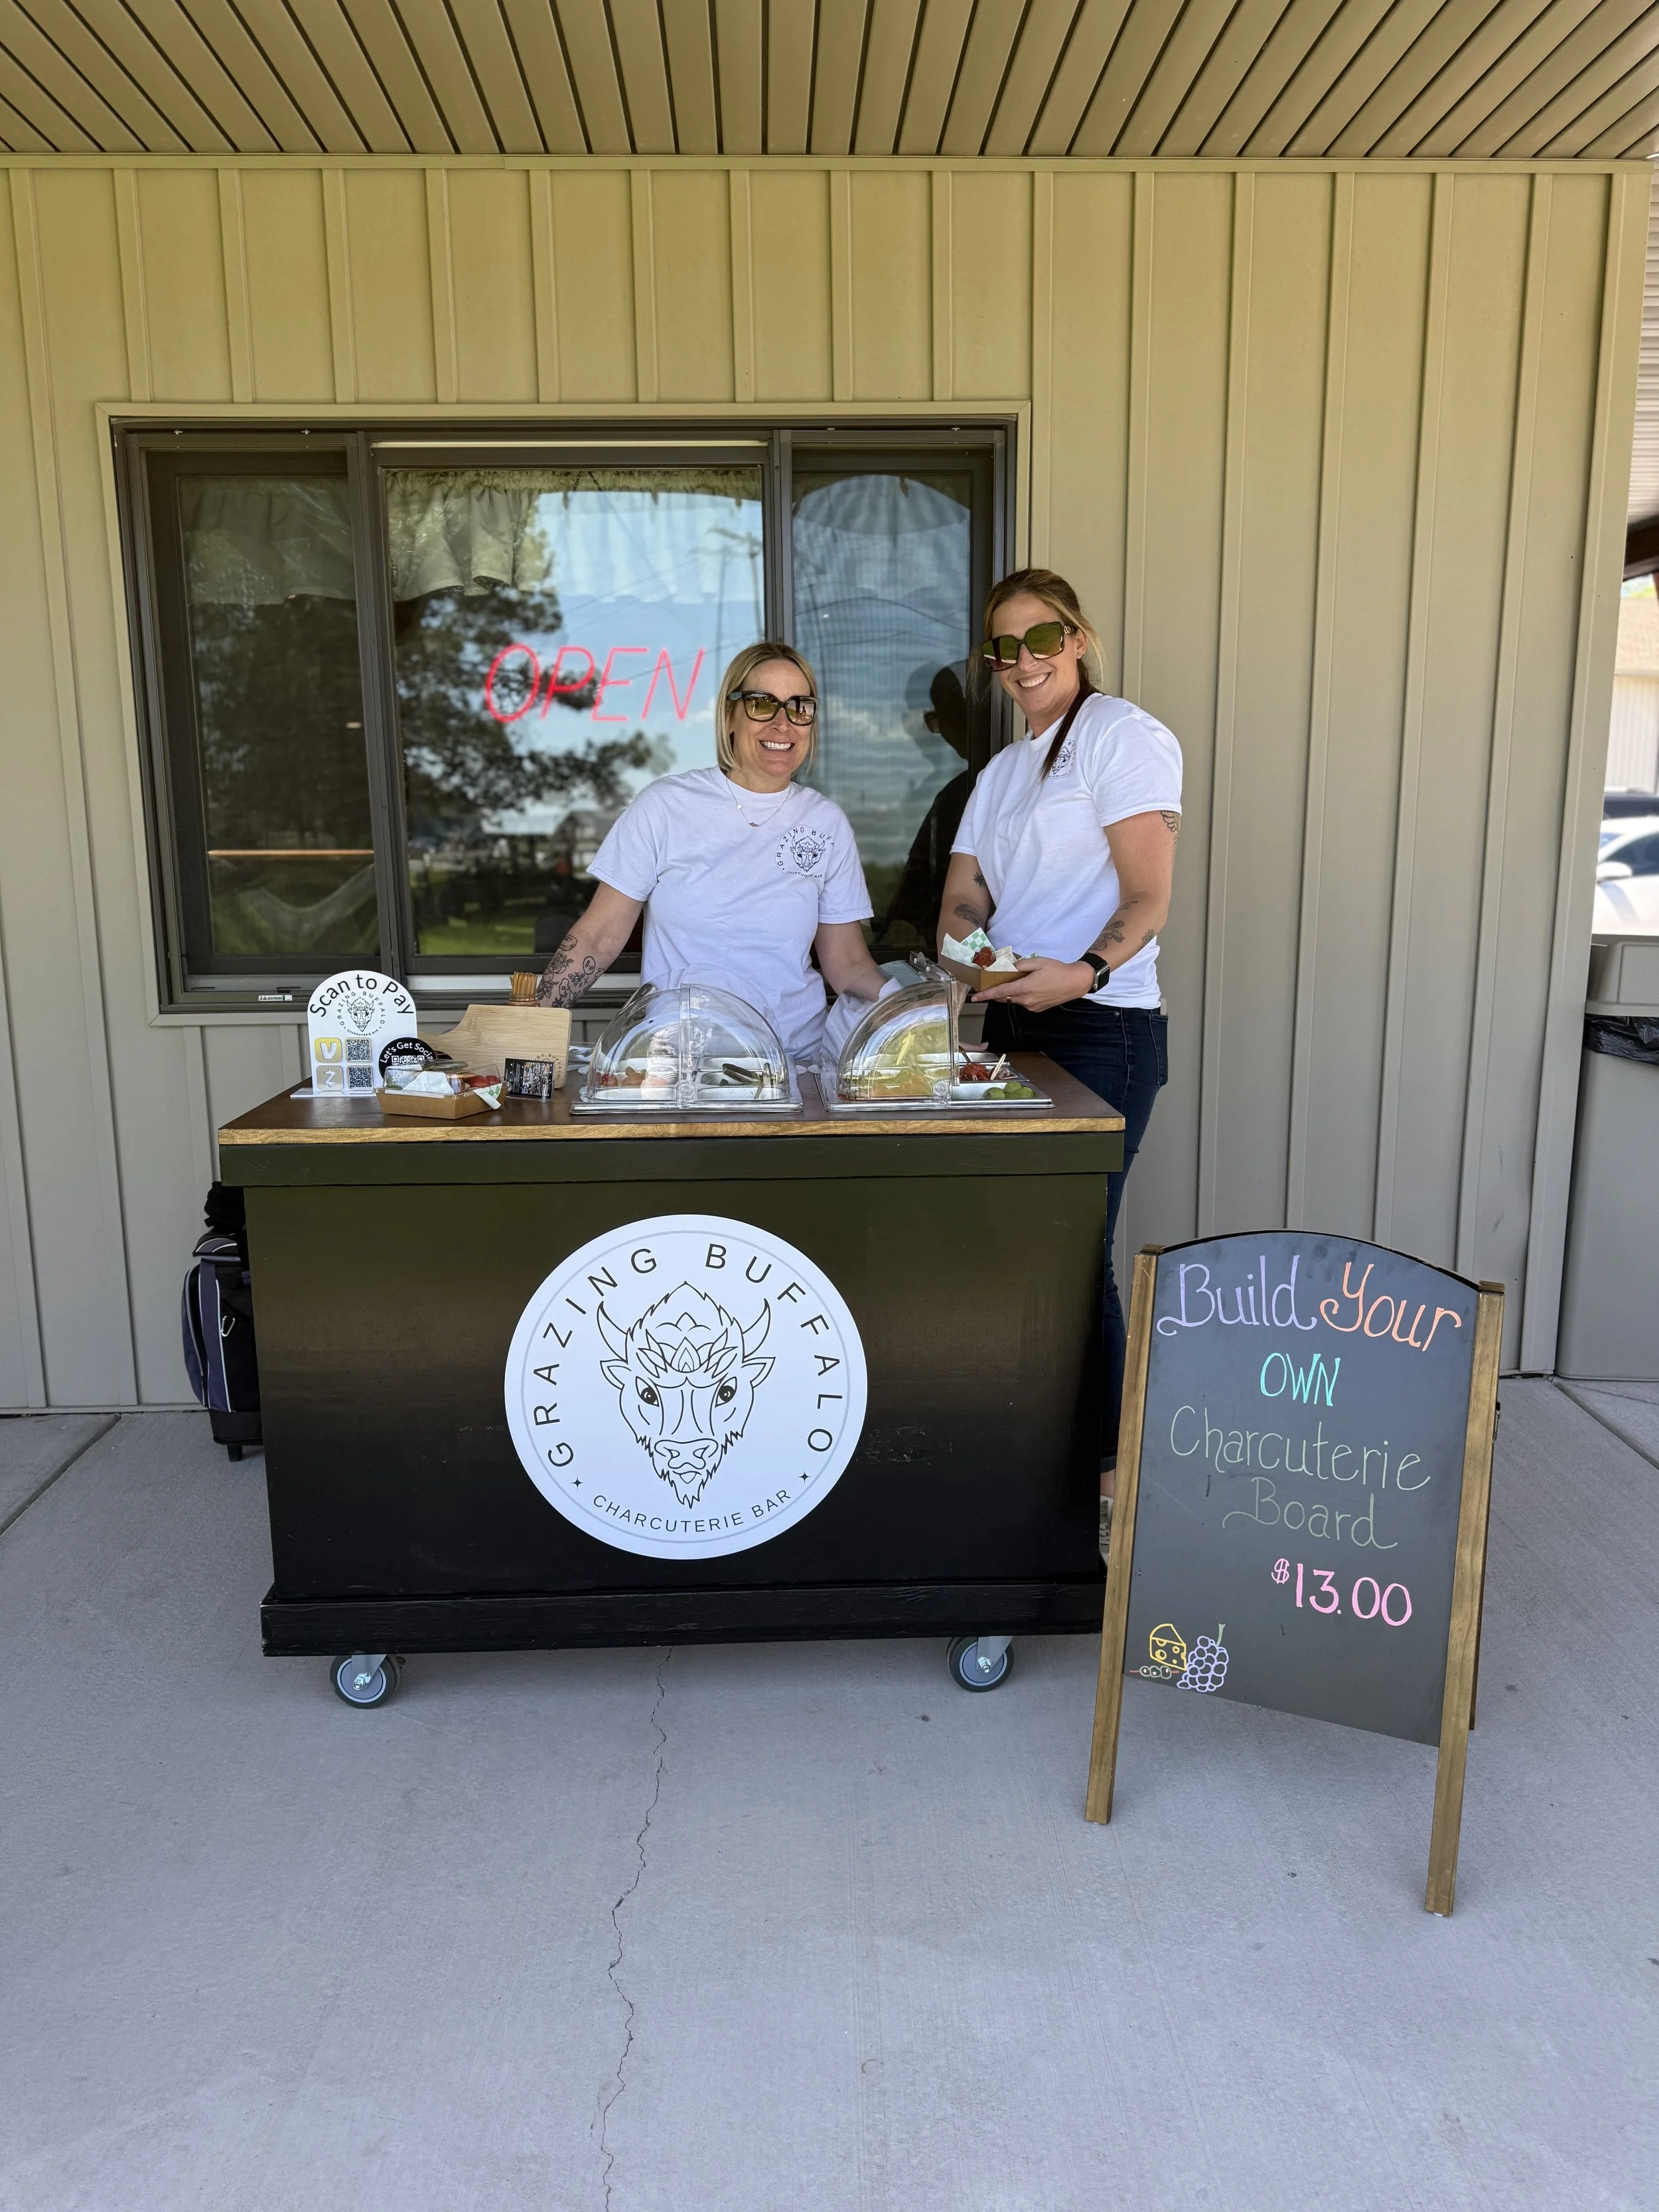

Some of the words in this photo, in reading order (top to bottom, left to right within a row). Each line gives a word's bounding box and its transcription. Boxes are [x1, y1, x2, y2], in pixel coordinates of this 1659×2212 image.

[484, 644, 705, 723] OPEN
[776, 827, 804, 866] GRAZING
[310, 980, 351, 1017] Scan
[355, 974, 378, 990] to
[382, 981, 414, 1014] Pay
[337, 992, 356, 1026] GRAZING
[362, 992, 386, 1025] BUFFALO
[379, 1047, 396, 1063] Let's
[414, 1043, 433, 1061] Socia
[1157, 1254, 1317, 1336] Build
[1320, 1262, 1462, 1352] Your
[533, 1249, 657, 1467] GRAZING
[705, 1243, 843, 1452] BUFFALO
[1261, 1352, 1340, 1407] OWN
[1171, 1406, 1431, 1491] Charcuterie
[594, 1495, 744, 1533] CHARCUTERIE
[752, 1490, 791, 1518] BAR
[1222, 1477, 1398, 1549] Board
[1271, 1558, 1412, 1626] $13.00
